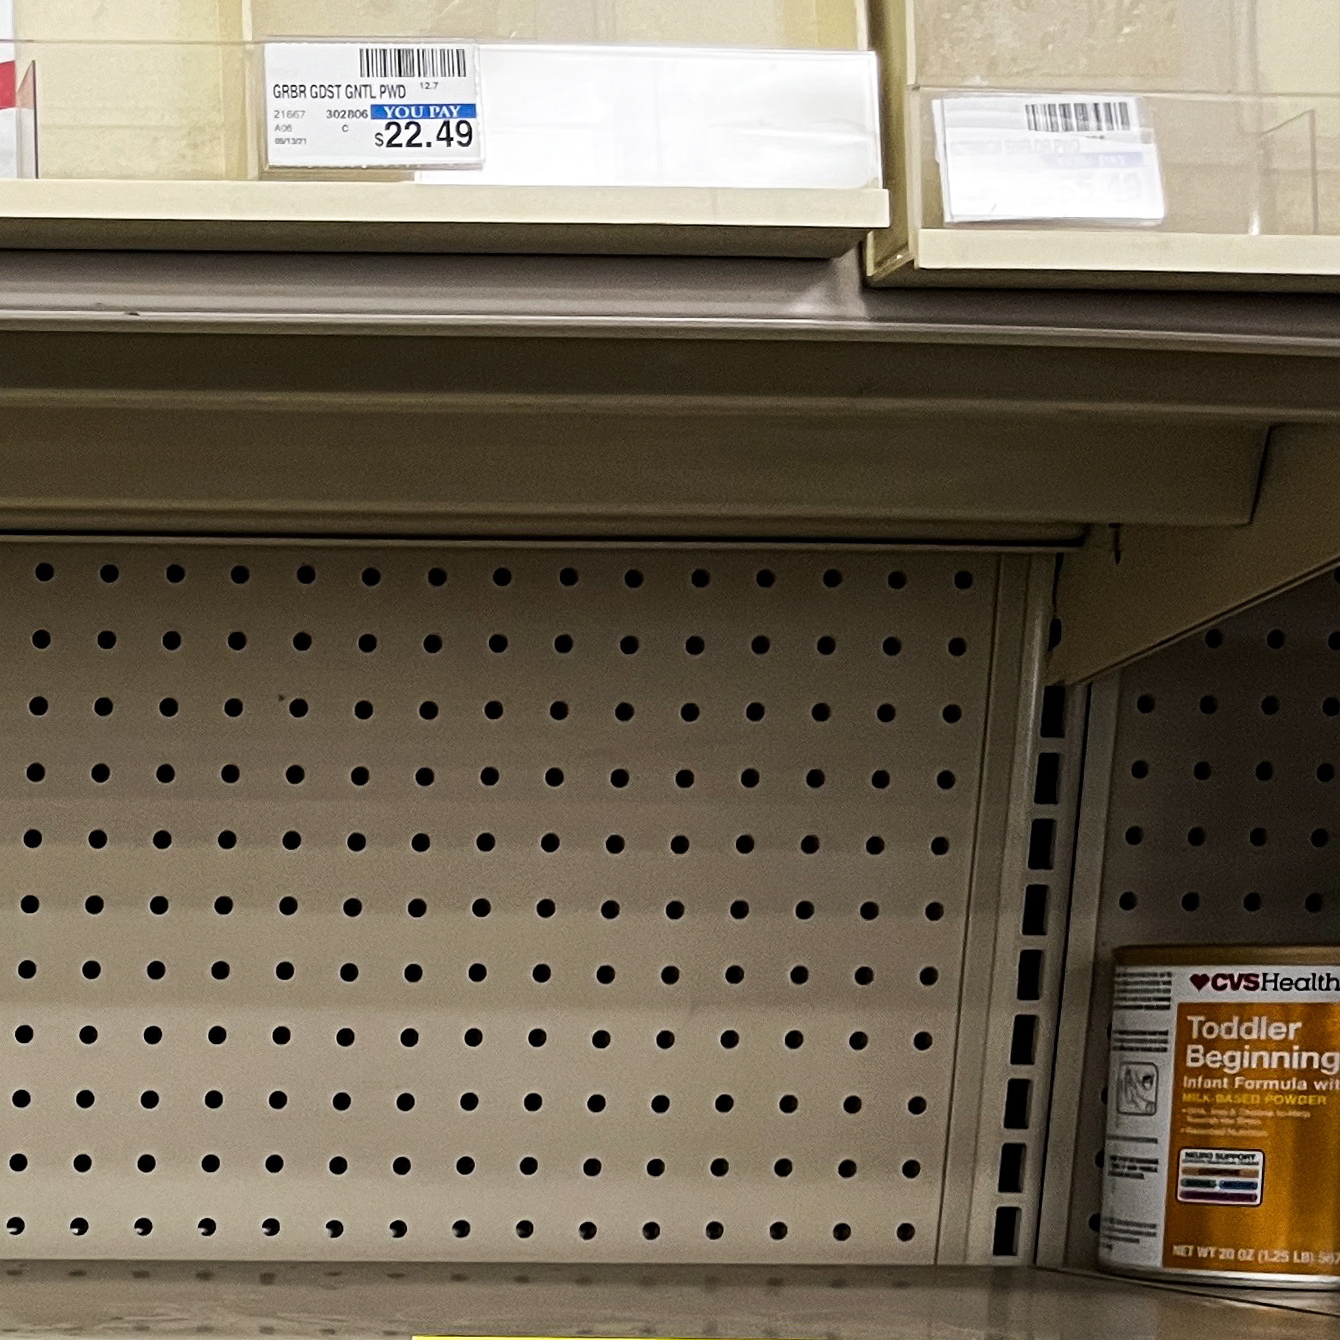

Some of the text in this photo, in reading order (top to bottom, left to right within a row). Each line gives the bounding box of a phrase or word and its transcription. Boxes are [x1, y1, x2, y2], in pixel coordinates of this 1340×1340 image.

[273, 84, 406, 99] GRBR GDST GNTL PWD
[326, 109, 369, 120] 302806
[383, 105, 461, 118] YOU PAY
[374, 120, 473, 148] $22.49
[1187, 1016, 1302, 1041] Toddler
[1185, 1044, 1340, 1074] Beginning
[1183, 1075, 1307, 1090] Infant Formula
